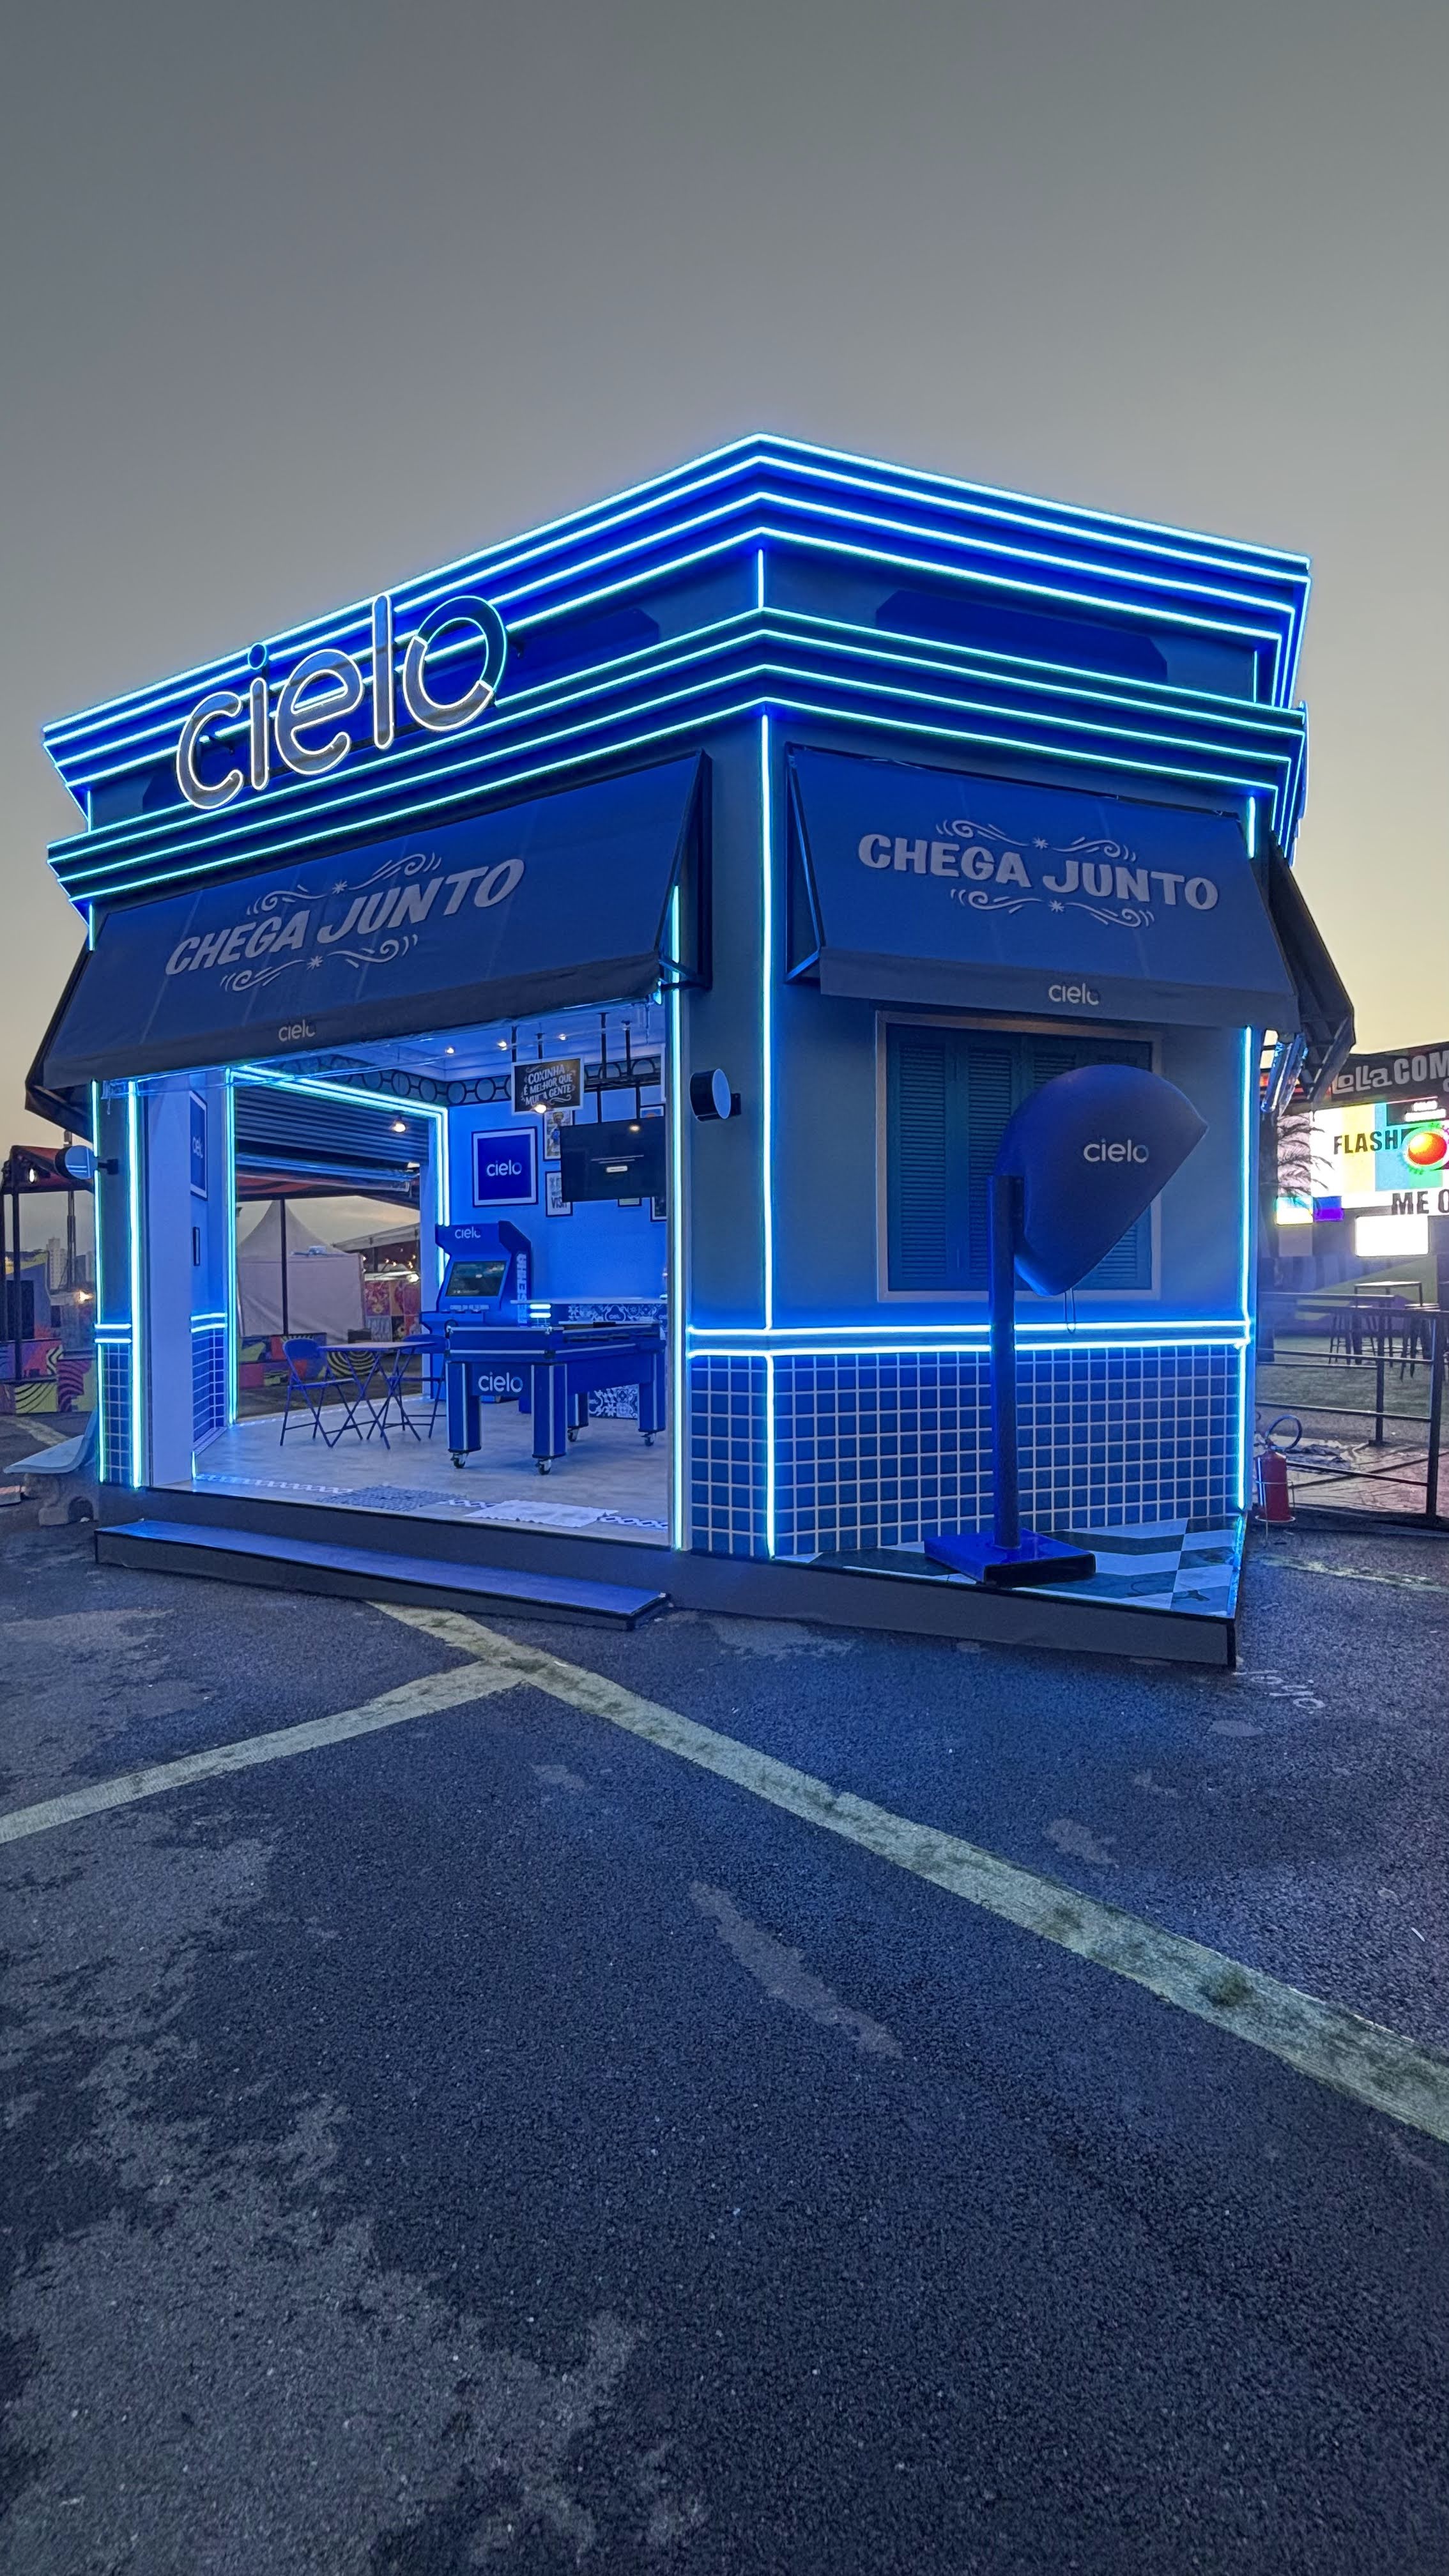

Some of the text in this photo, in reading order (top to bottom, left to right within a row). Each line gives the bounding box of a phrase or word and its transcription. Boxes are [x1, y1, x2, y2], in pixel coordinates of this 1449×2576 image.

[176, 594, 507, 809] cielo
[859, 834, 1218, 910] CHEGA JUNTO
[165, 859, 525, 975] CHEGA JUNTO
[524, 1073, 573, 1096] É MELHOR QUE
[528, 1064, 565, 1084] COXINHA
[549, 1084, 572, 1098] GENTE
[1083, 1137, 1149, 1163] cielo
[486, 1160, 523, 1177] cielo
[1392, 1191, 1430, 1215] ME
[478, 1372, 523, 1393] cielo
